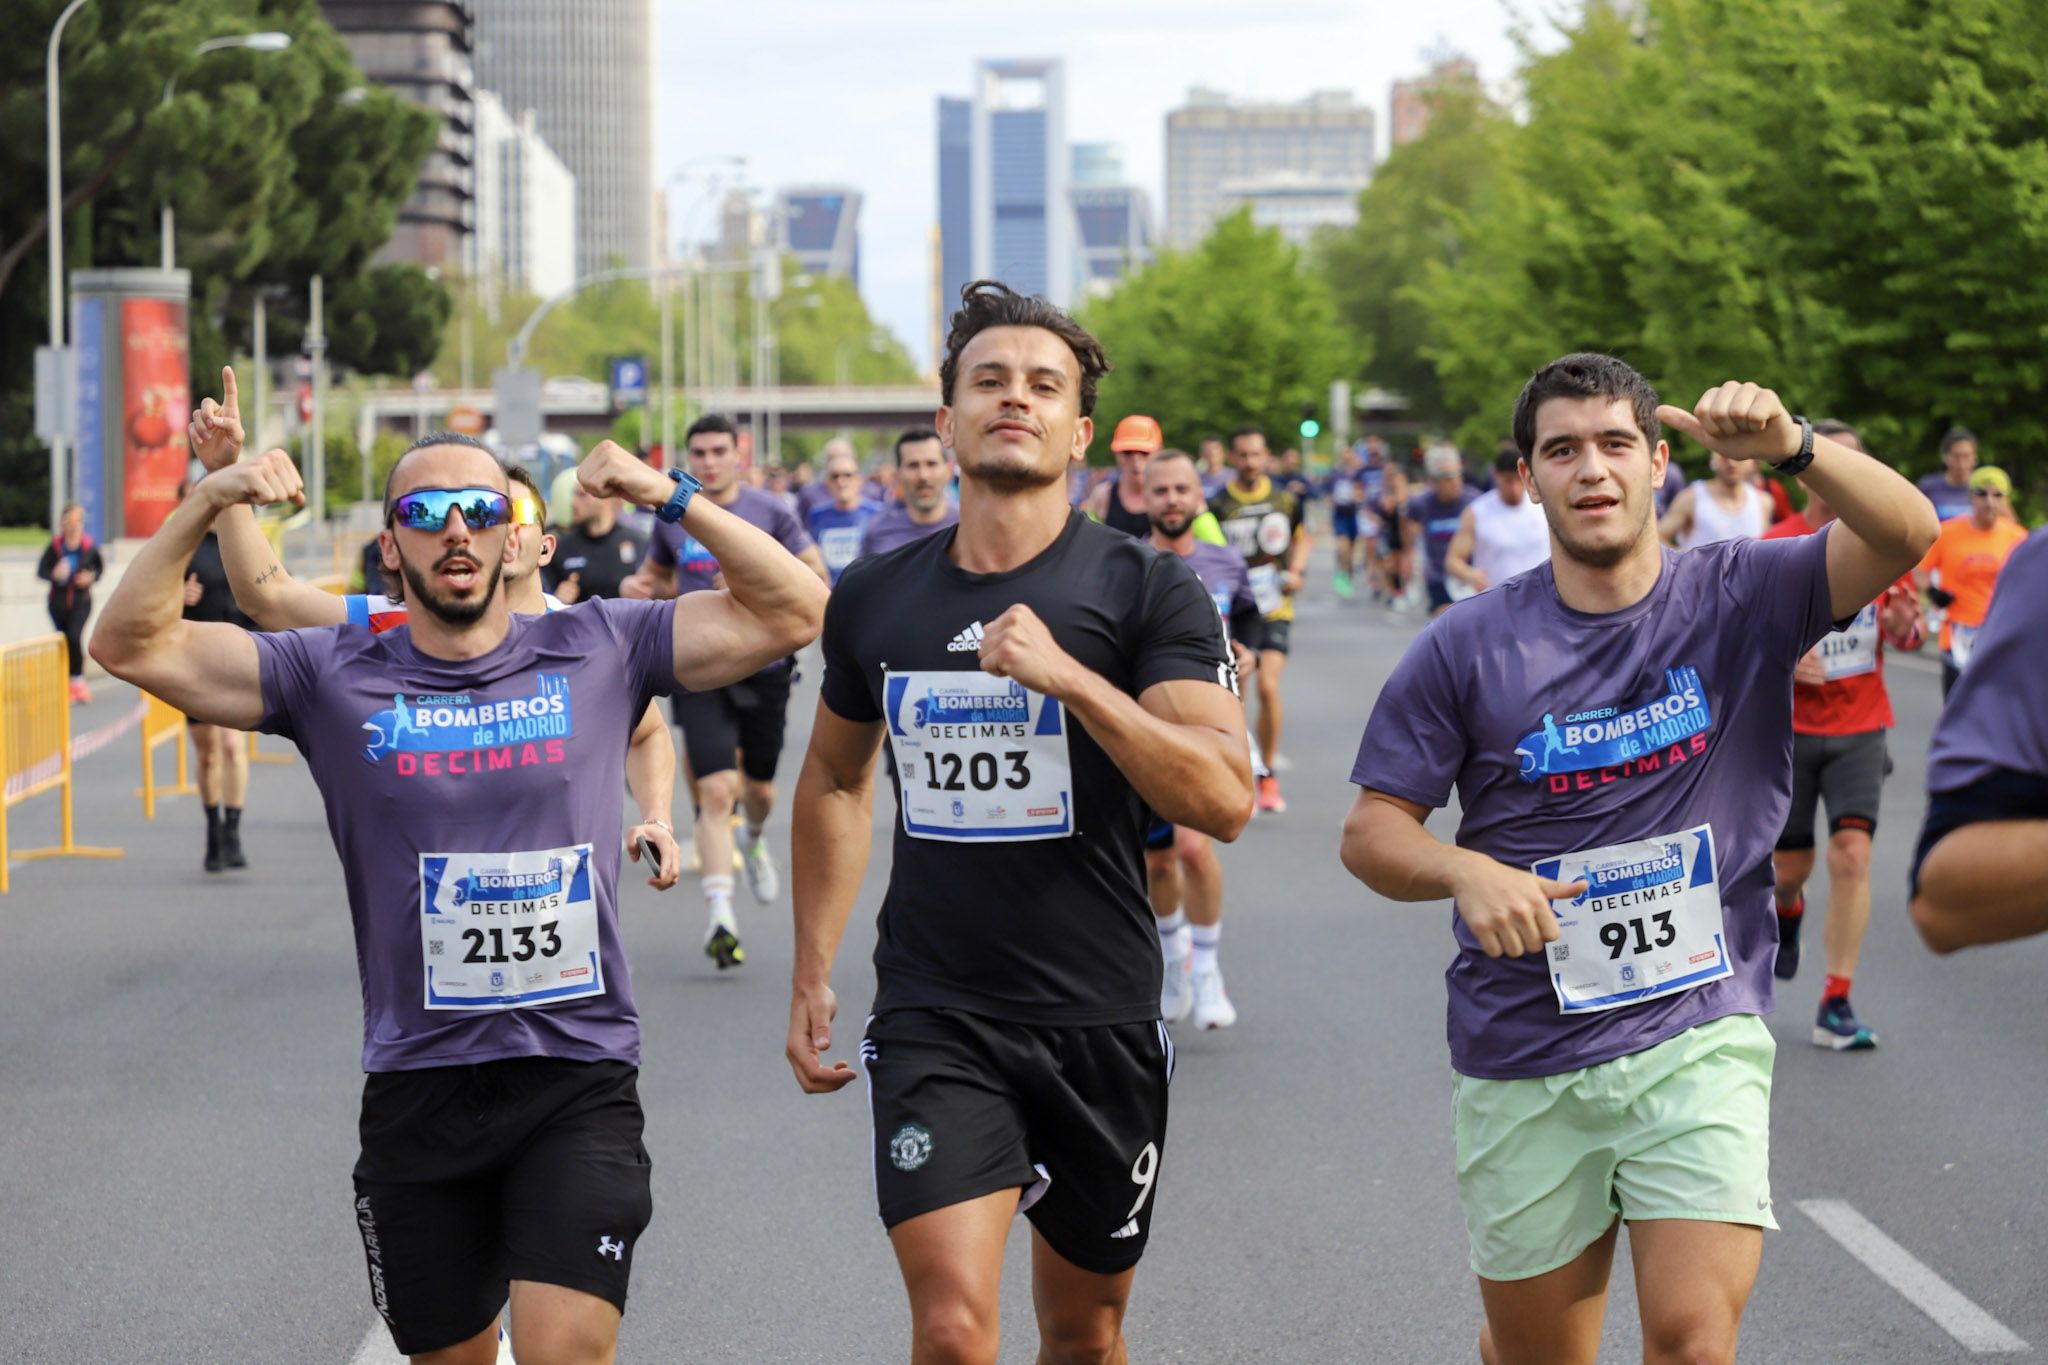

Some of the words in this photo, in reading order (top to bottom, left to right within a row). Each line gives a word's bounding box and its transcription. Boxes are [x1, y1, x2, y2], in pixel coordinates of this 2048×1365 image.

[619, 363, 640, 388] P
[416, 695, 471, 705] CARRERA
[416, 695, 565, 728] BOMBEROS
[938, 696, 1025, 709] BOMBEROS
[971, 710, 984, 721] de
[986, 710, 1026, 721] MADRID
[1566, 707, 1618, 723] CARRERA
[1566, 688, 1700, 747] BOMBEROS
[473, 726, 494, 746] de
[499, 714, 567, 743] MADRID
[930, 725, 1025, 738] DECIMAS
[1620, 736, 1641, 758] de
[1644, 707, 1706, 750] MADRID
[397, 740, 566, 776] DECIMAS
[924, 750, 1031, 791] 1203
[1550, 732, 1708, 794] DECIMAS
[480, 869, 559, 888] BOMBEROS
[1597, 860, 1627, 870] CARRERA
[1597, 854, 1681, 883] BOMBEROS
[1631, 877, 1645, 890] de
[1647, 866, 1683, 887] MADRID
[512, 888, 524, 899] de
[528, 880, 560, 899] MADRID
[1592, 882, 1682, 912] DECIMAS
[471, 895, 559, 915] DECIMAS
[462, 920, 562, 964] 2133
[1600, 910, 1676, 960] 913
[1127, 1141, 1159, 1220] 9
[356, 1196, 383, 1264] ARMUR
